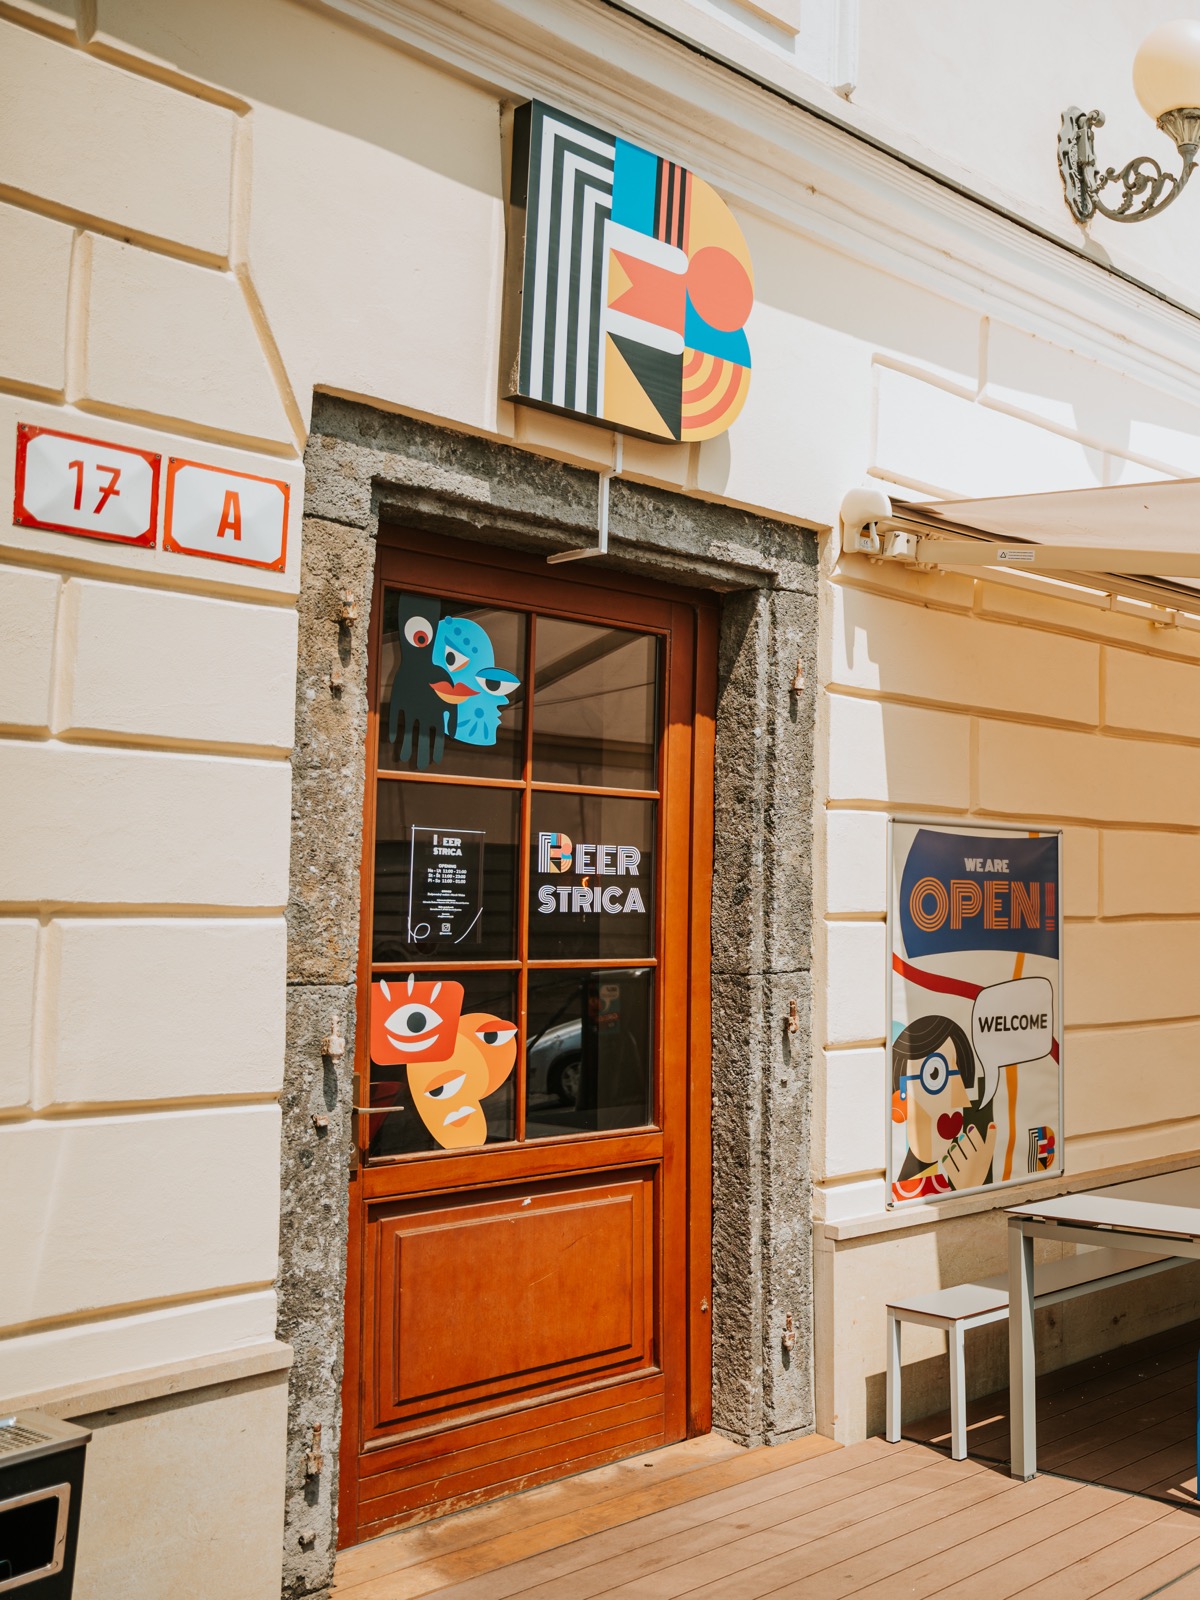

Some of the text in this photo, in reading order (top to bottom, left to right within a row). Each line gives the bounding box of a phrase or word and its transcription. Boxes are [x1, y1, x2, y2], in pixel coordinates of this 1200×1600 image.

[68, 459, 122, 515] 17
[216, 489, 242, 542] A
[433, 847, 462, 856] STRICA
[538, 831, 641, 876] BEER
[964, 857, 1010, 873] WE ARE
[537, 885, 646, 914] STRICA
[909, 877, 1056, 932] OPEN!
[978, 1013, 1048, 1033] WELCOME
